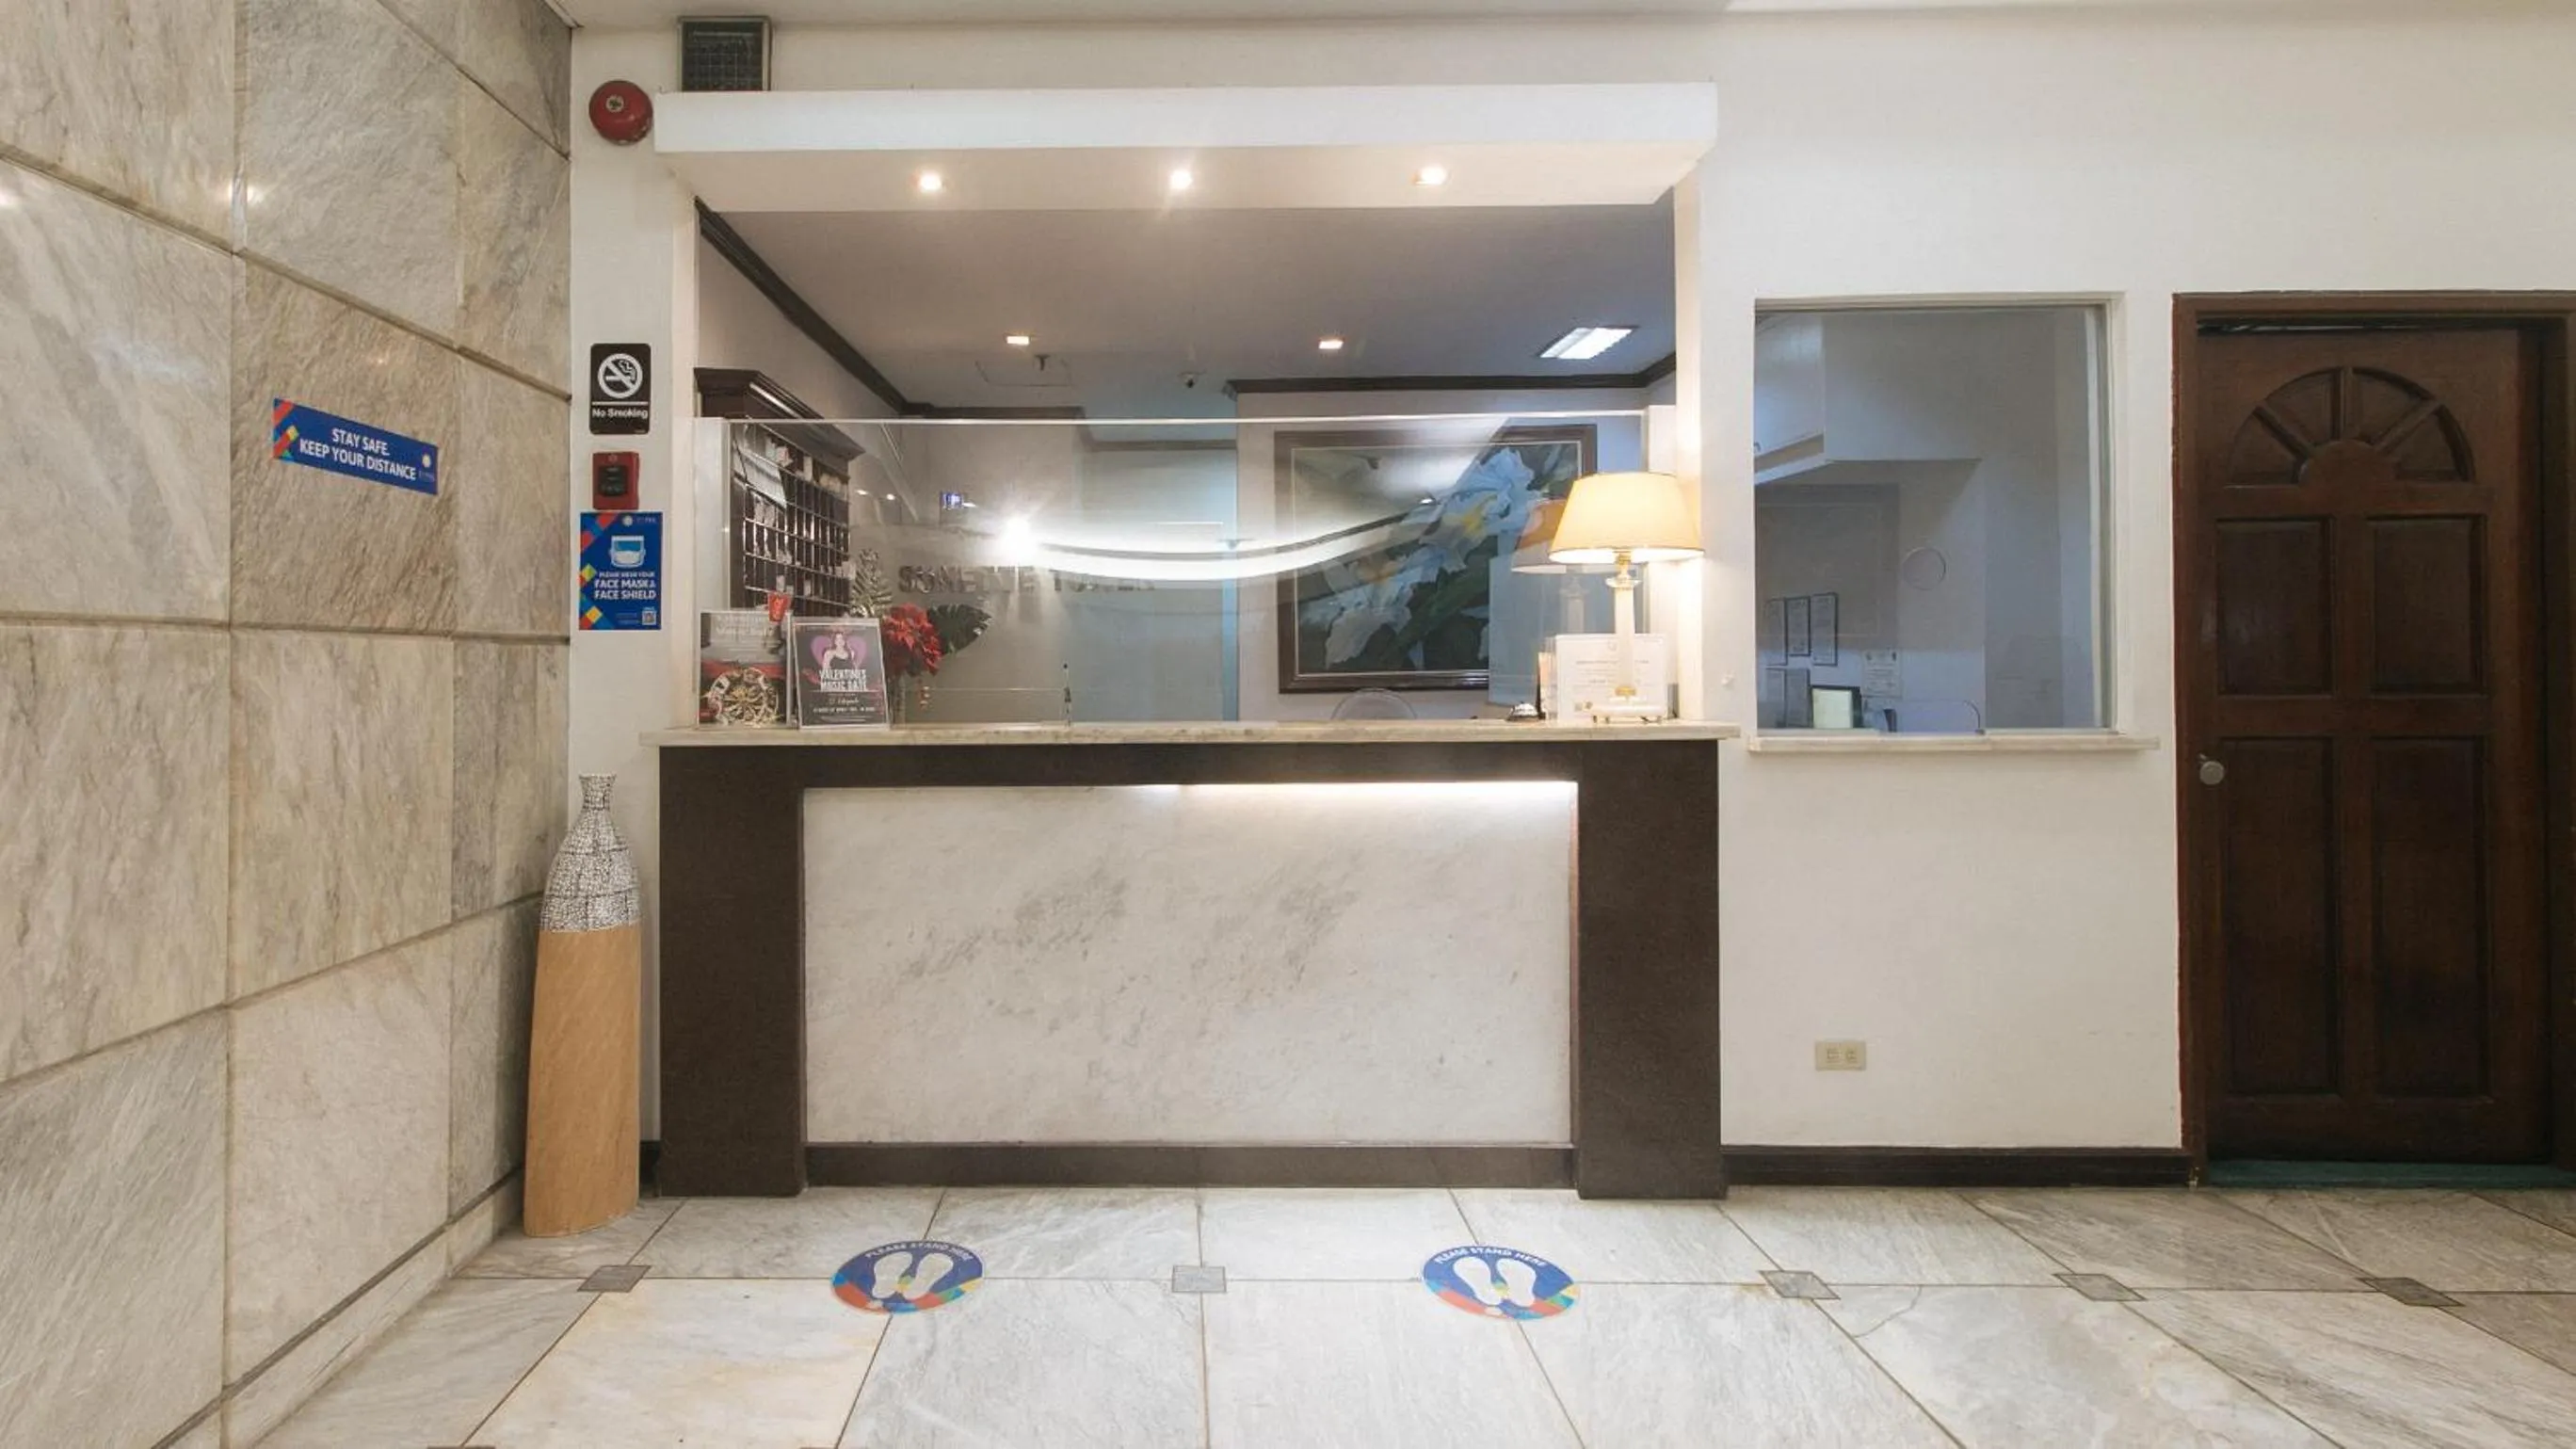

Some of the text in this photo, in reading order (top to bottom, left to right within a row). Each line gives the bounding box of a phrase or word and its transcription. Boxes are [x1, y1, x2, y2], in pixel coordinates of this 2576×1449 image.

[592, 408, 649, 419] No Smoking
[331, 428, 360, 448] STAY
[299, 439, 330, 459] KEEP
[331, 447, 364, 467] YOUR
[366, 456, 416, 480] DISTANCE
[594, 579, 620, 588] FACE
[621, 579, 649, 588] MASK
[594, 590, 656, 600] FACE SHIELD
[865, 1243, 907, 1258] PLEASE
[910, 1243, 948, 1251] STAND
[1434, 1248, 1547, 1267] PLEASE STAND HERE
